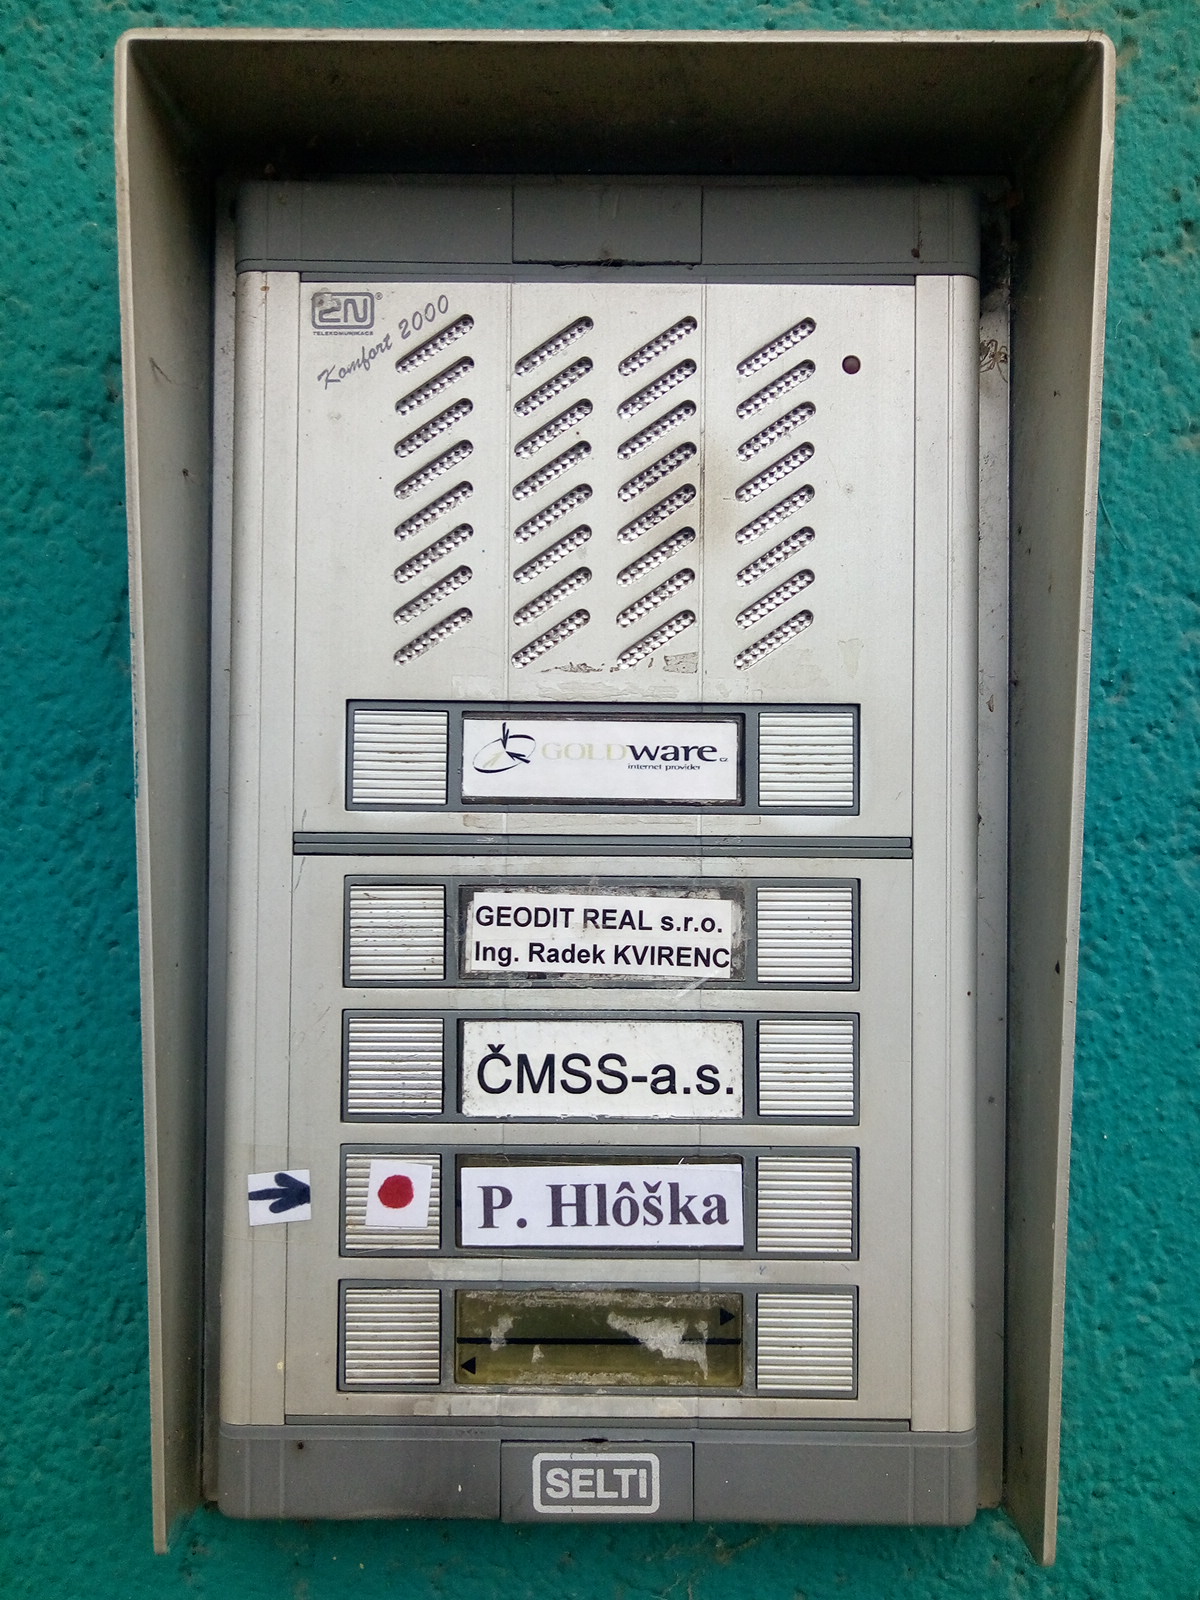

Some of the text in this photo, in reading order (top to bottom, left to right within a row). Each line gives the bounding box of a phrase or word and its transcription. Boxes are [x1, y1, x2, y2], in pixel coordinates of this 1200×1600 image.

[317, 294, 449, 390] Komfort 2000
[628, 763, 701, 772] internet provider
[475, 905, 723, 933] GEODIT REAL s.r.o.
[474, 941, 730, 968] Ing. Radek KVIRENC
[477, 1044, 734, 1095] ČMSS-a.s.
[477, 1180, 730, 1229] P. Hlôška
[546, 1467, 648, 1499] SELTI
